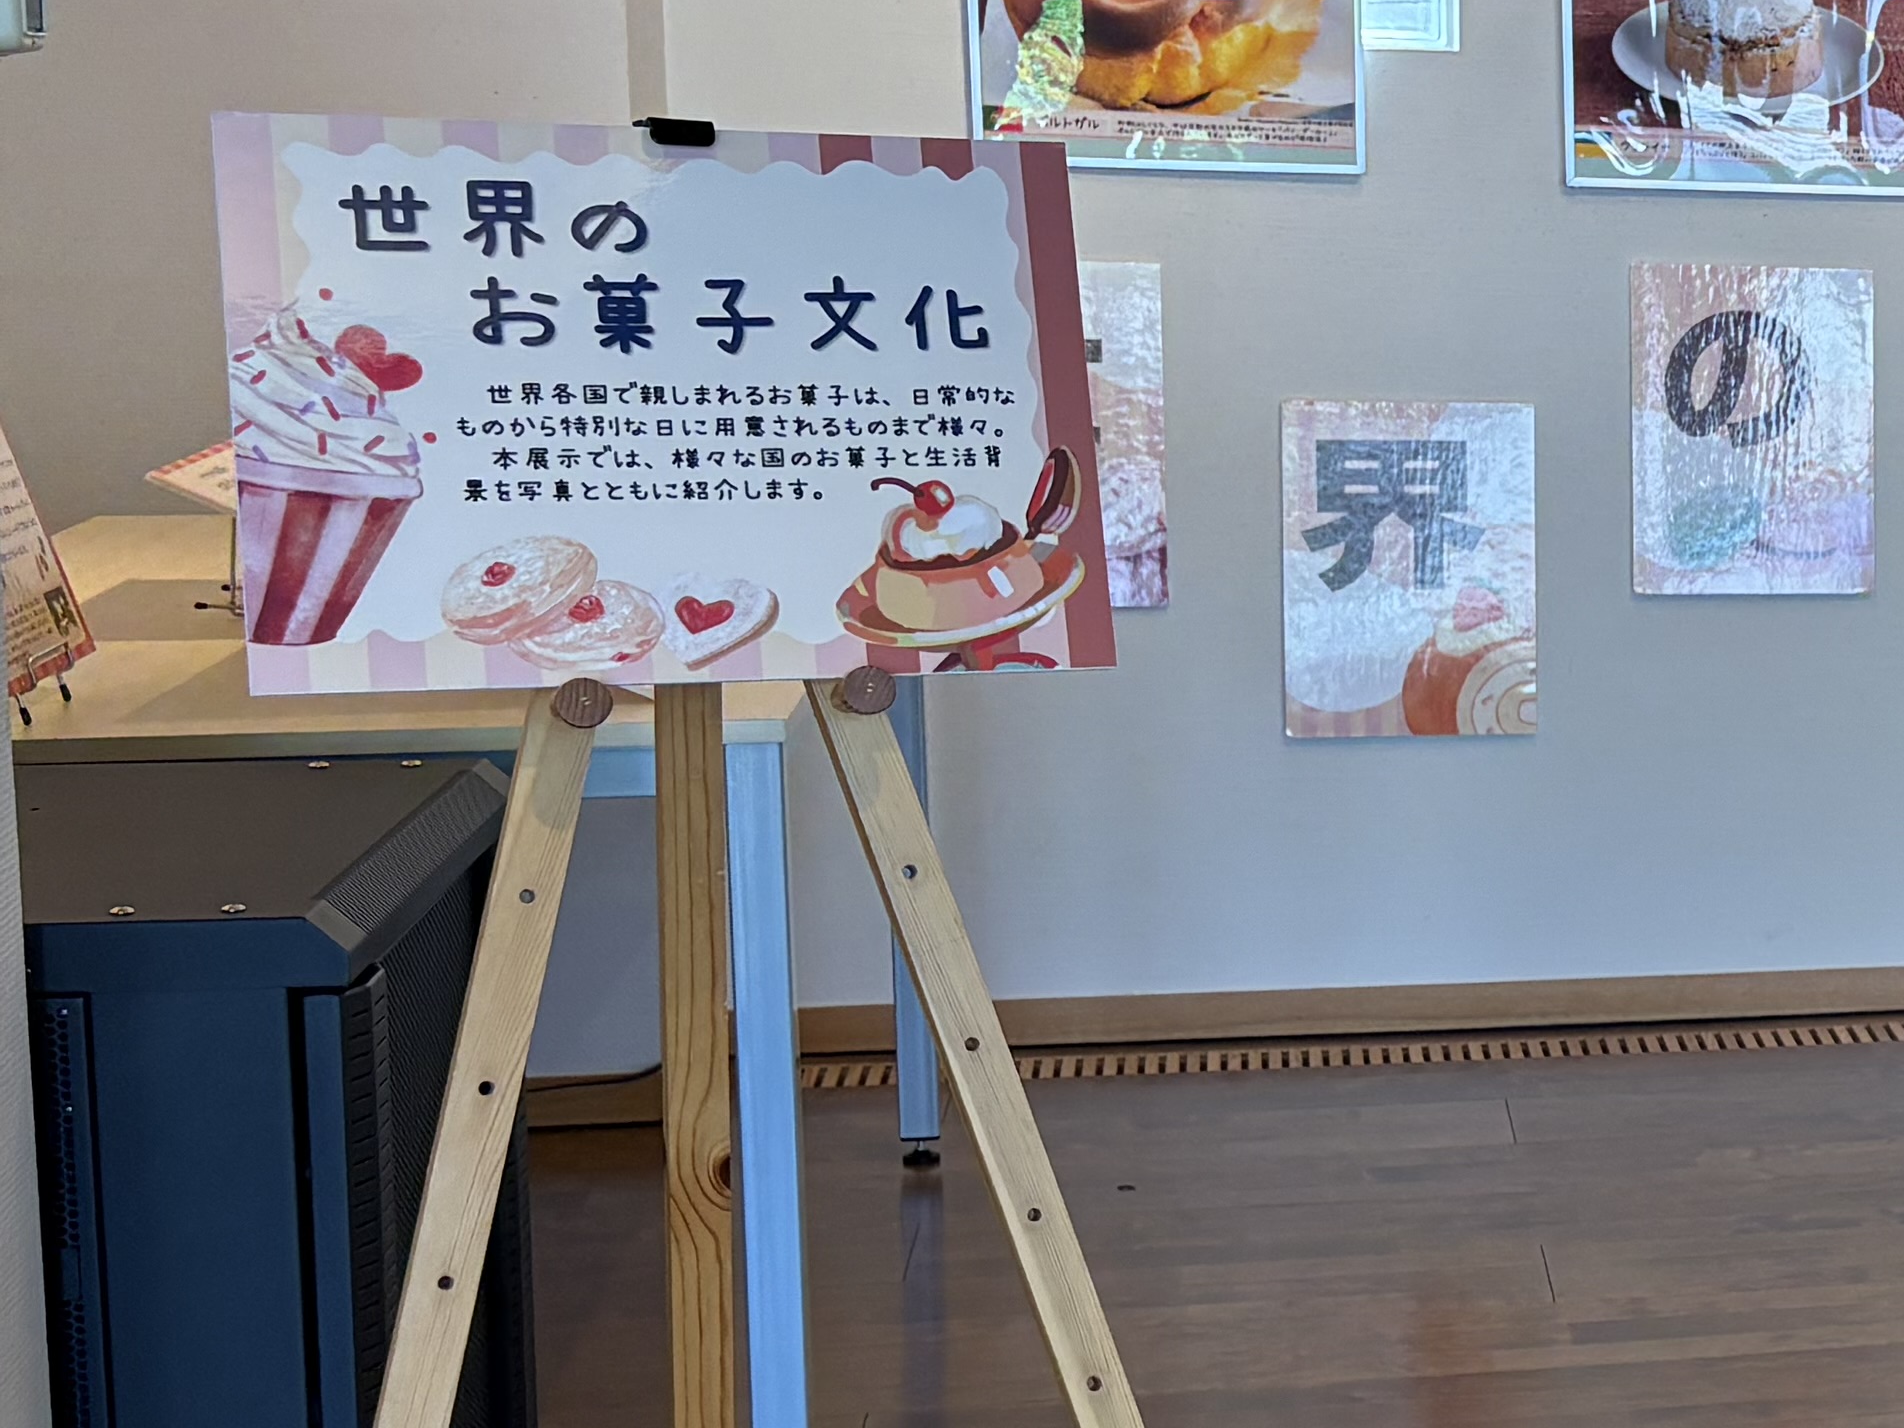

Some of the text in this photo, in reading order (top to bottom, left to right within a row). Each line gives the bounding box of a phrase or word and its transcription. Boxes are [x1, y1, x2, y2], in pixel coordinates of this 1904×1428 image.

[338, 178, 651, 257] 世界の
[470, 273, 989, 353] お菓子文化
[486, 381, 1016, 410] 世界各国で親しまれるお菓子は、日常的な
[1664, 309, 1807, 449] の
[455, 410, 1007, 440] ものから特別な日に用意されるものまで様々。
[491, 444, 1004, 473] 本展示では、様々な国のお菓子と生活背
[463, 477, 824, 506] 景を写真とともに紹介します。
[1300, 439, 1486, 592] 界
